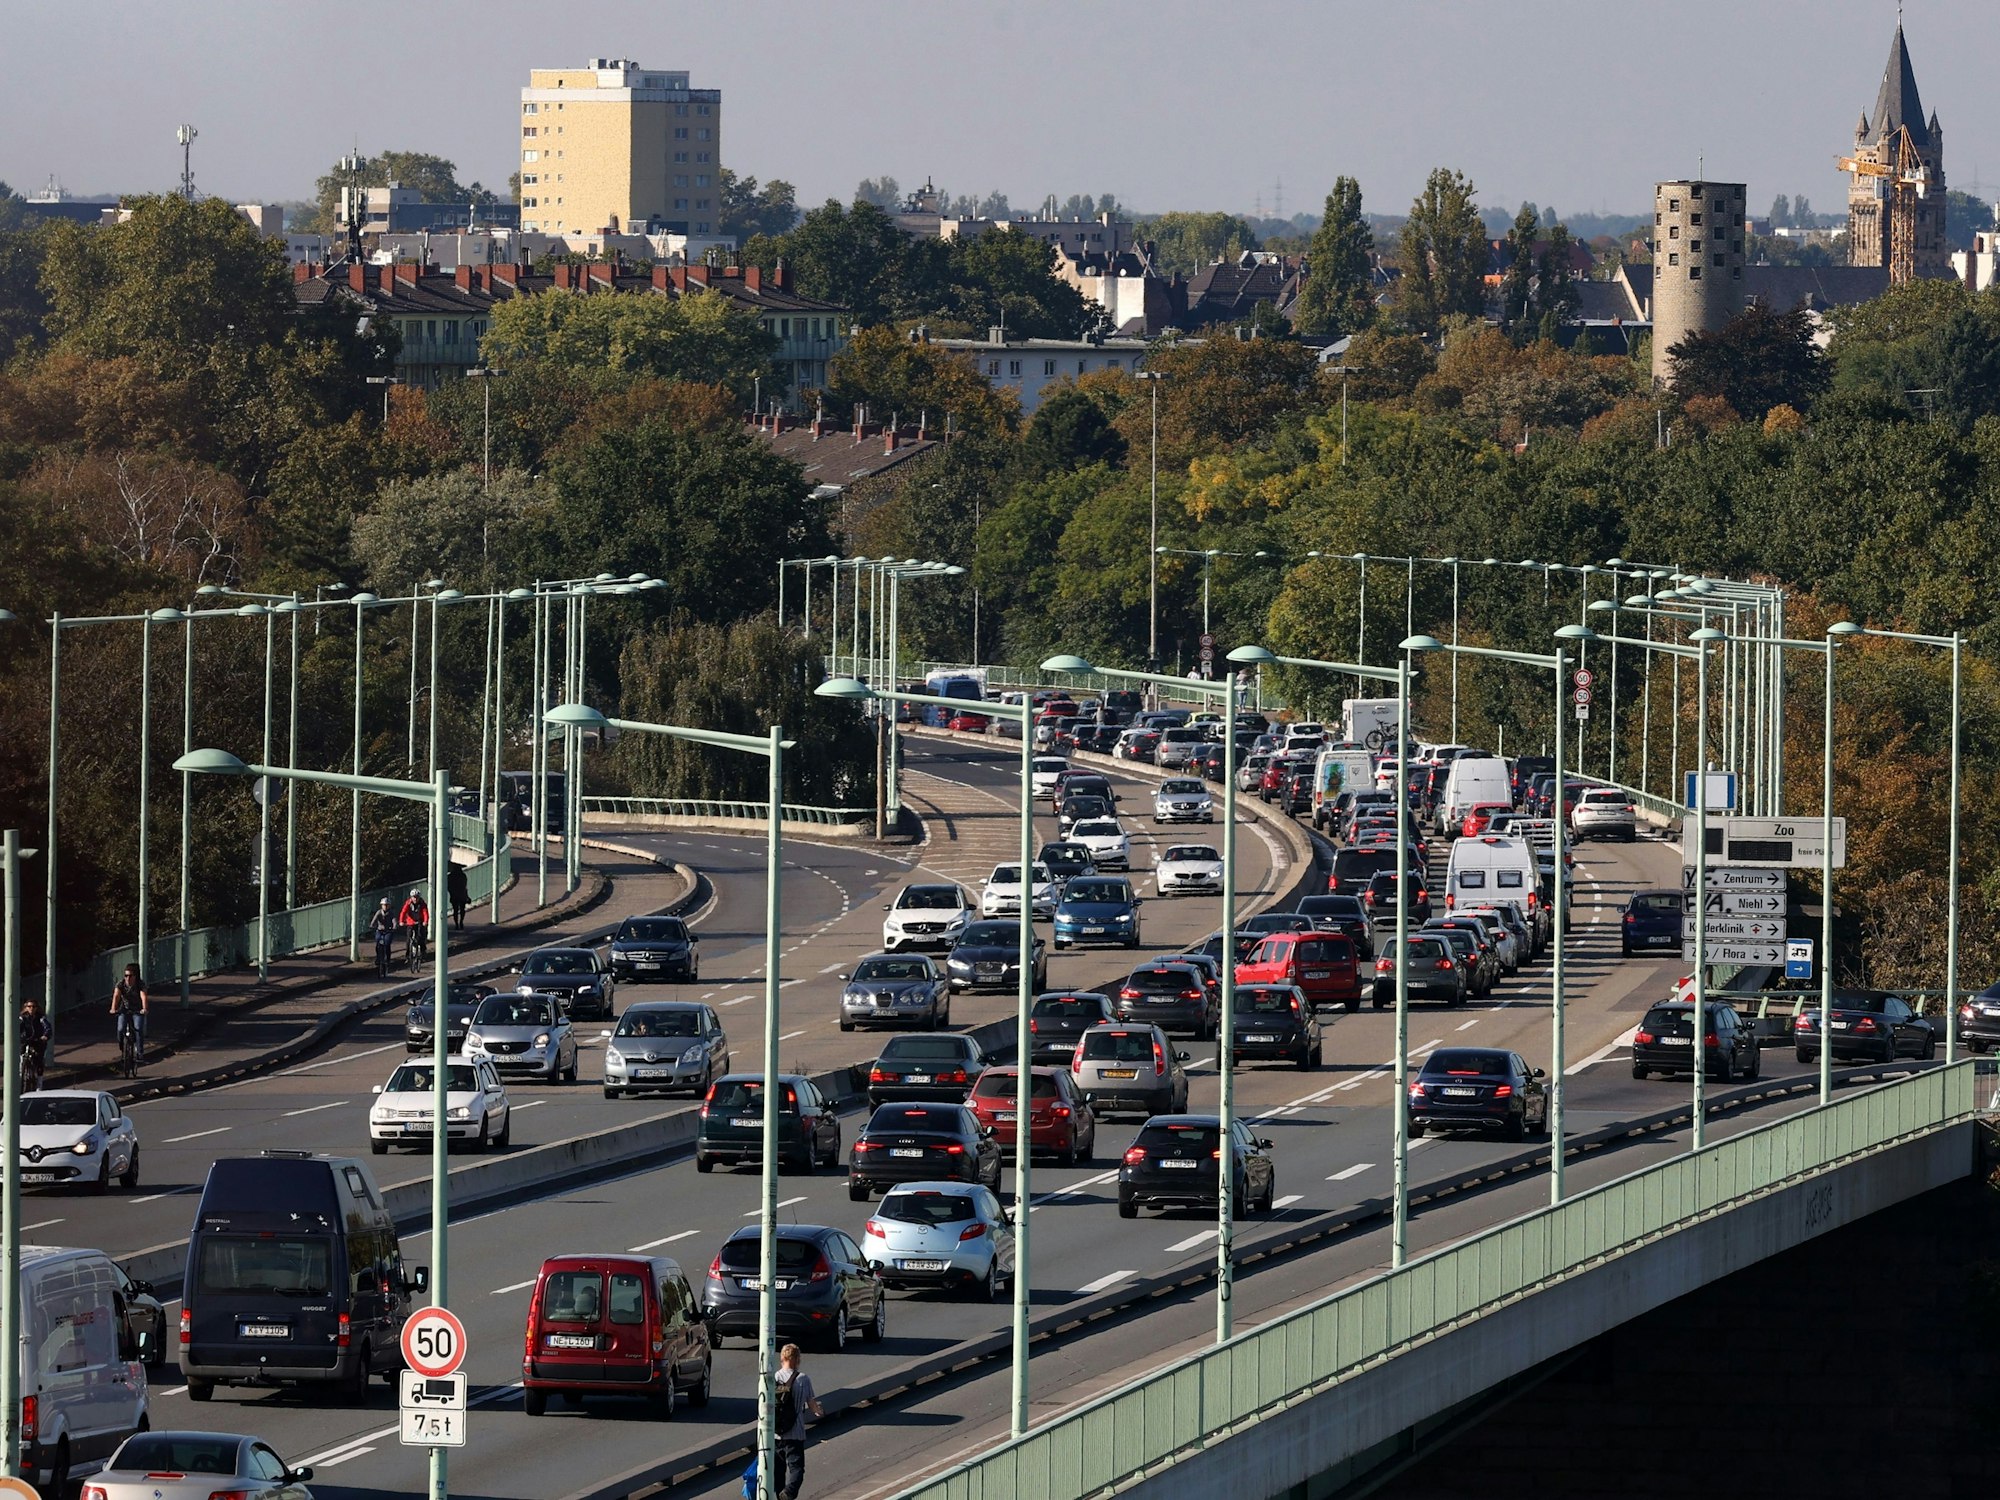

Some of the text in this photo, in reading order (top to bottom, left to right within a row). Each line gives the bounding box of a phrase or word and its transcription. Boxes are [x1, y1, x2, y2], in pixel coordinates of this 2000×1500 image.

[1774, 824, 1795, 836] Zoo
[1724, 874, 1763, 884] Zentrum
[1738, 899, 1763, 908] Niehl
[1689, 922, 1744, 933] Kderklinik
[1691, 947, 1709, 958] Zo
[1723, 948, 1746, 959] Flora
[417, 1328, 452, 1358] 50
